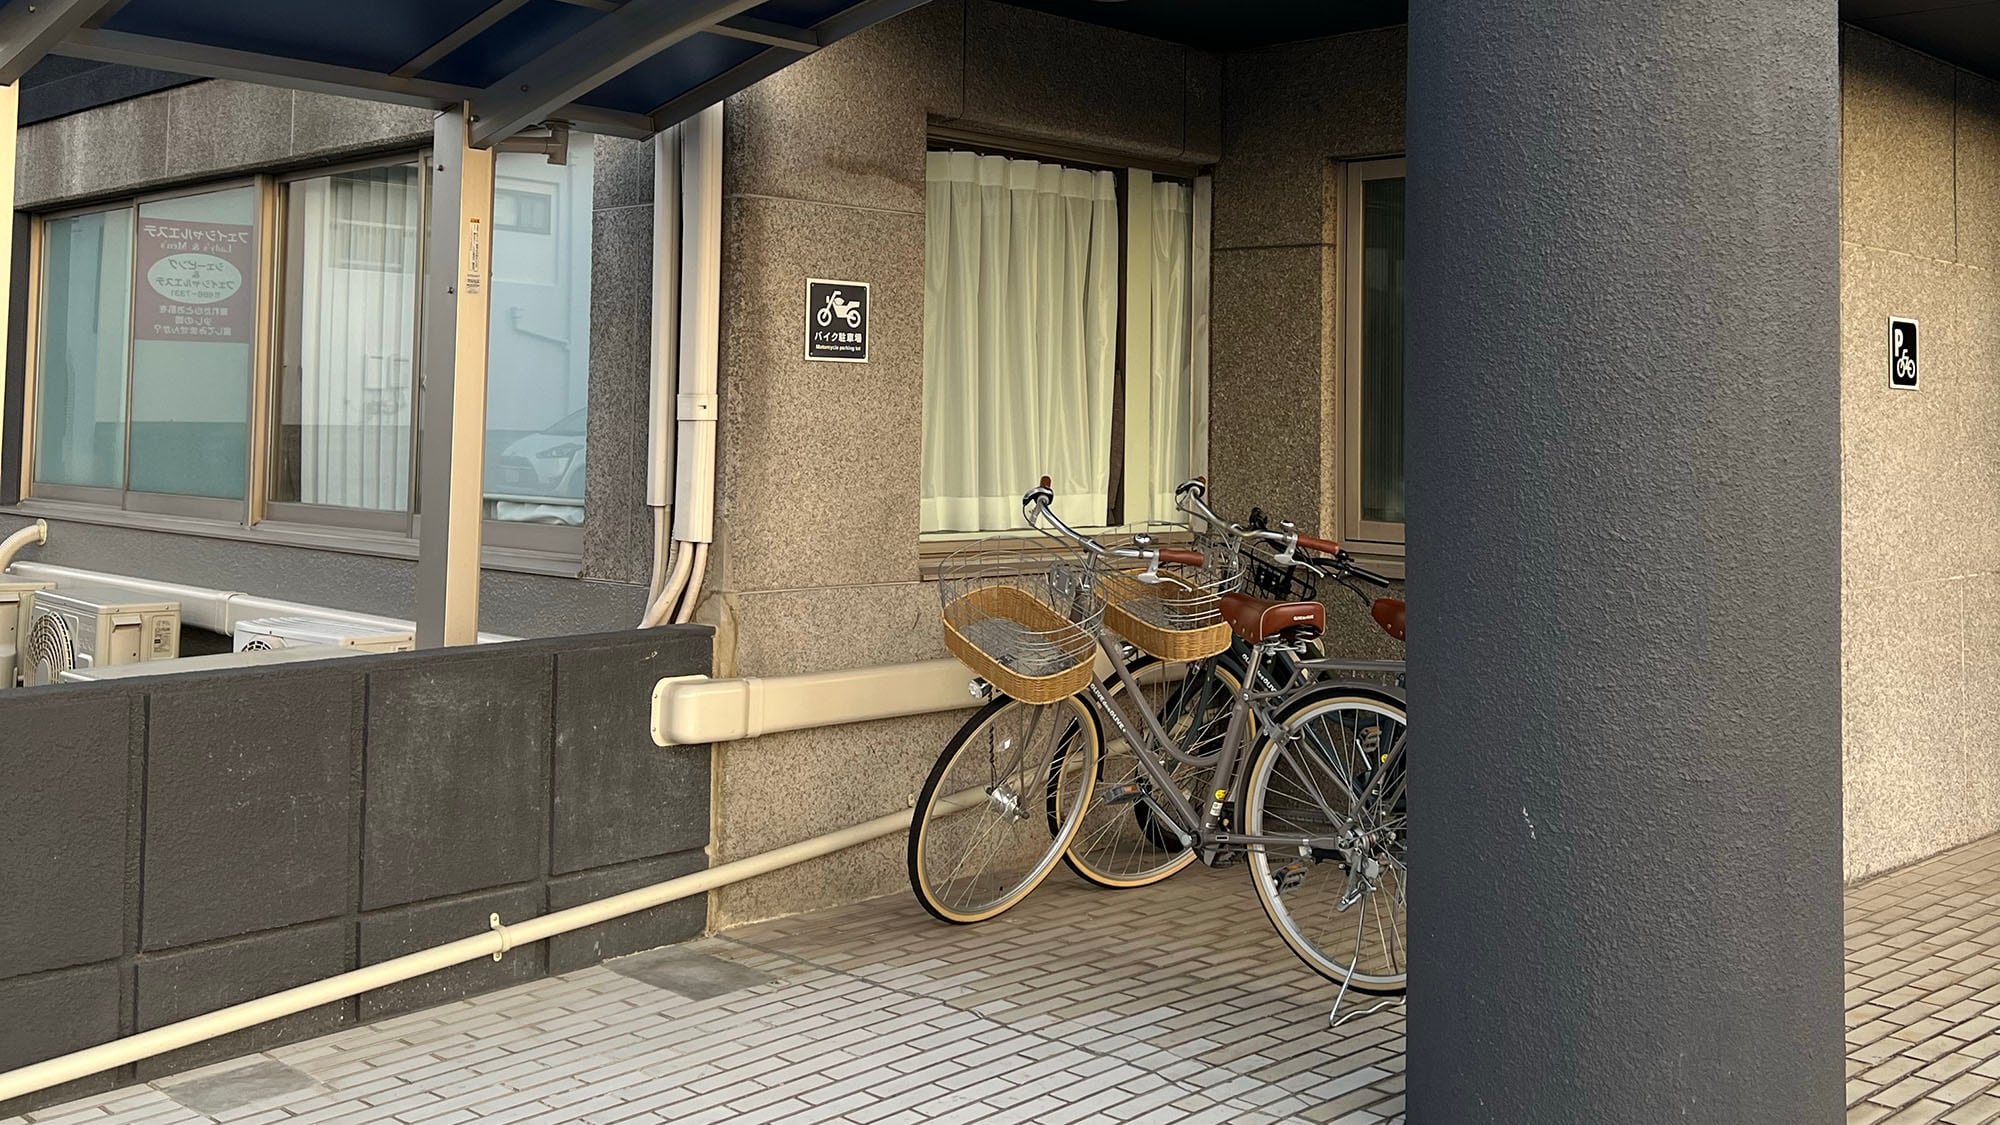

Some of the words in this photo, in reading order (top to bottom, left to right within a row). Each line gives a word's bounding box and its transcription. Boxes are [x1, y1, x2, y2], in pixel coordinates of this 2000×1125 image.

[814, 331, 862, 343] バイク駐車場
[1894, 328, 1904, 357] P
